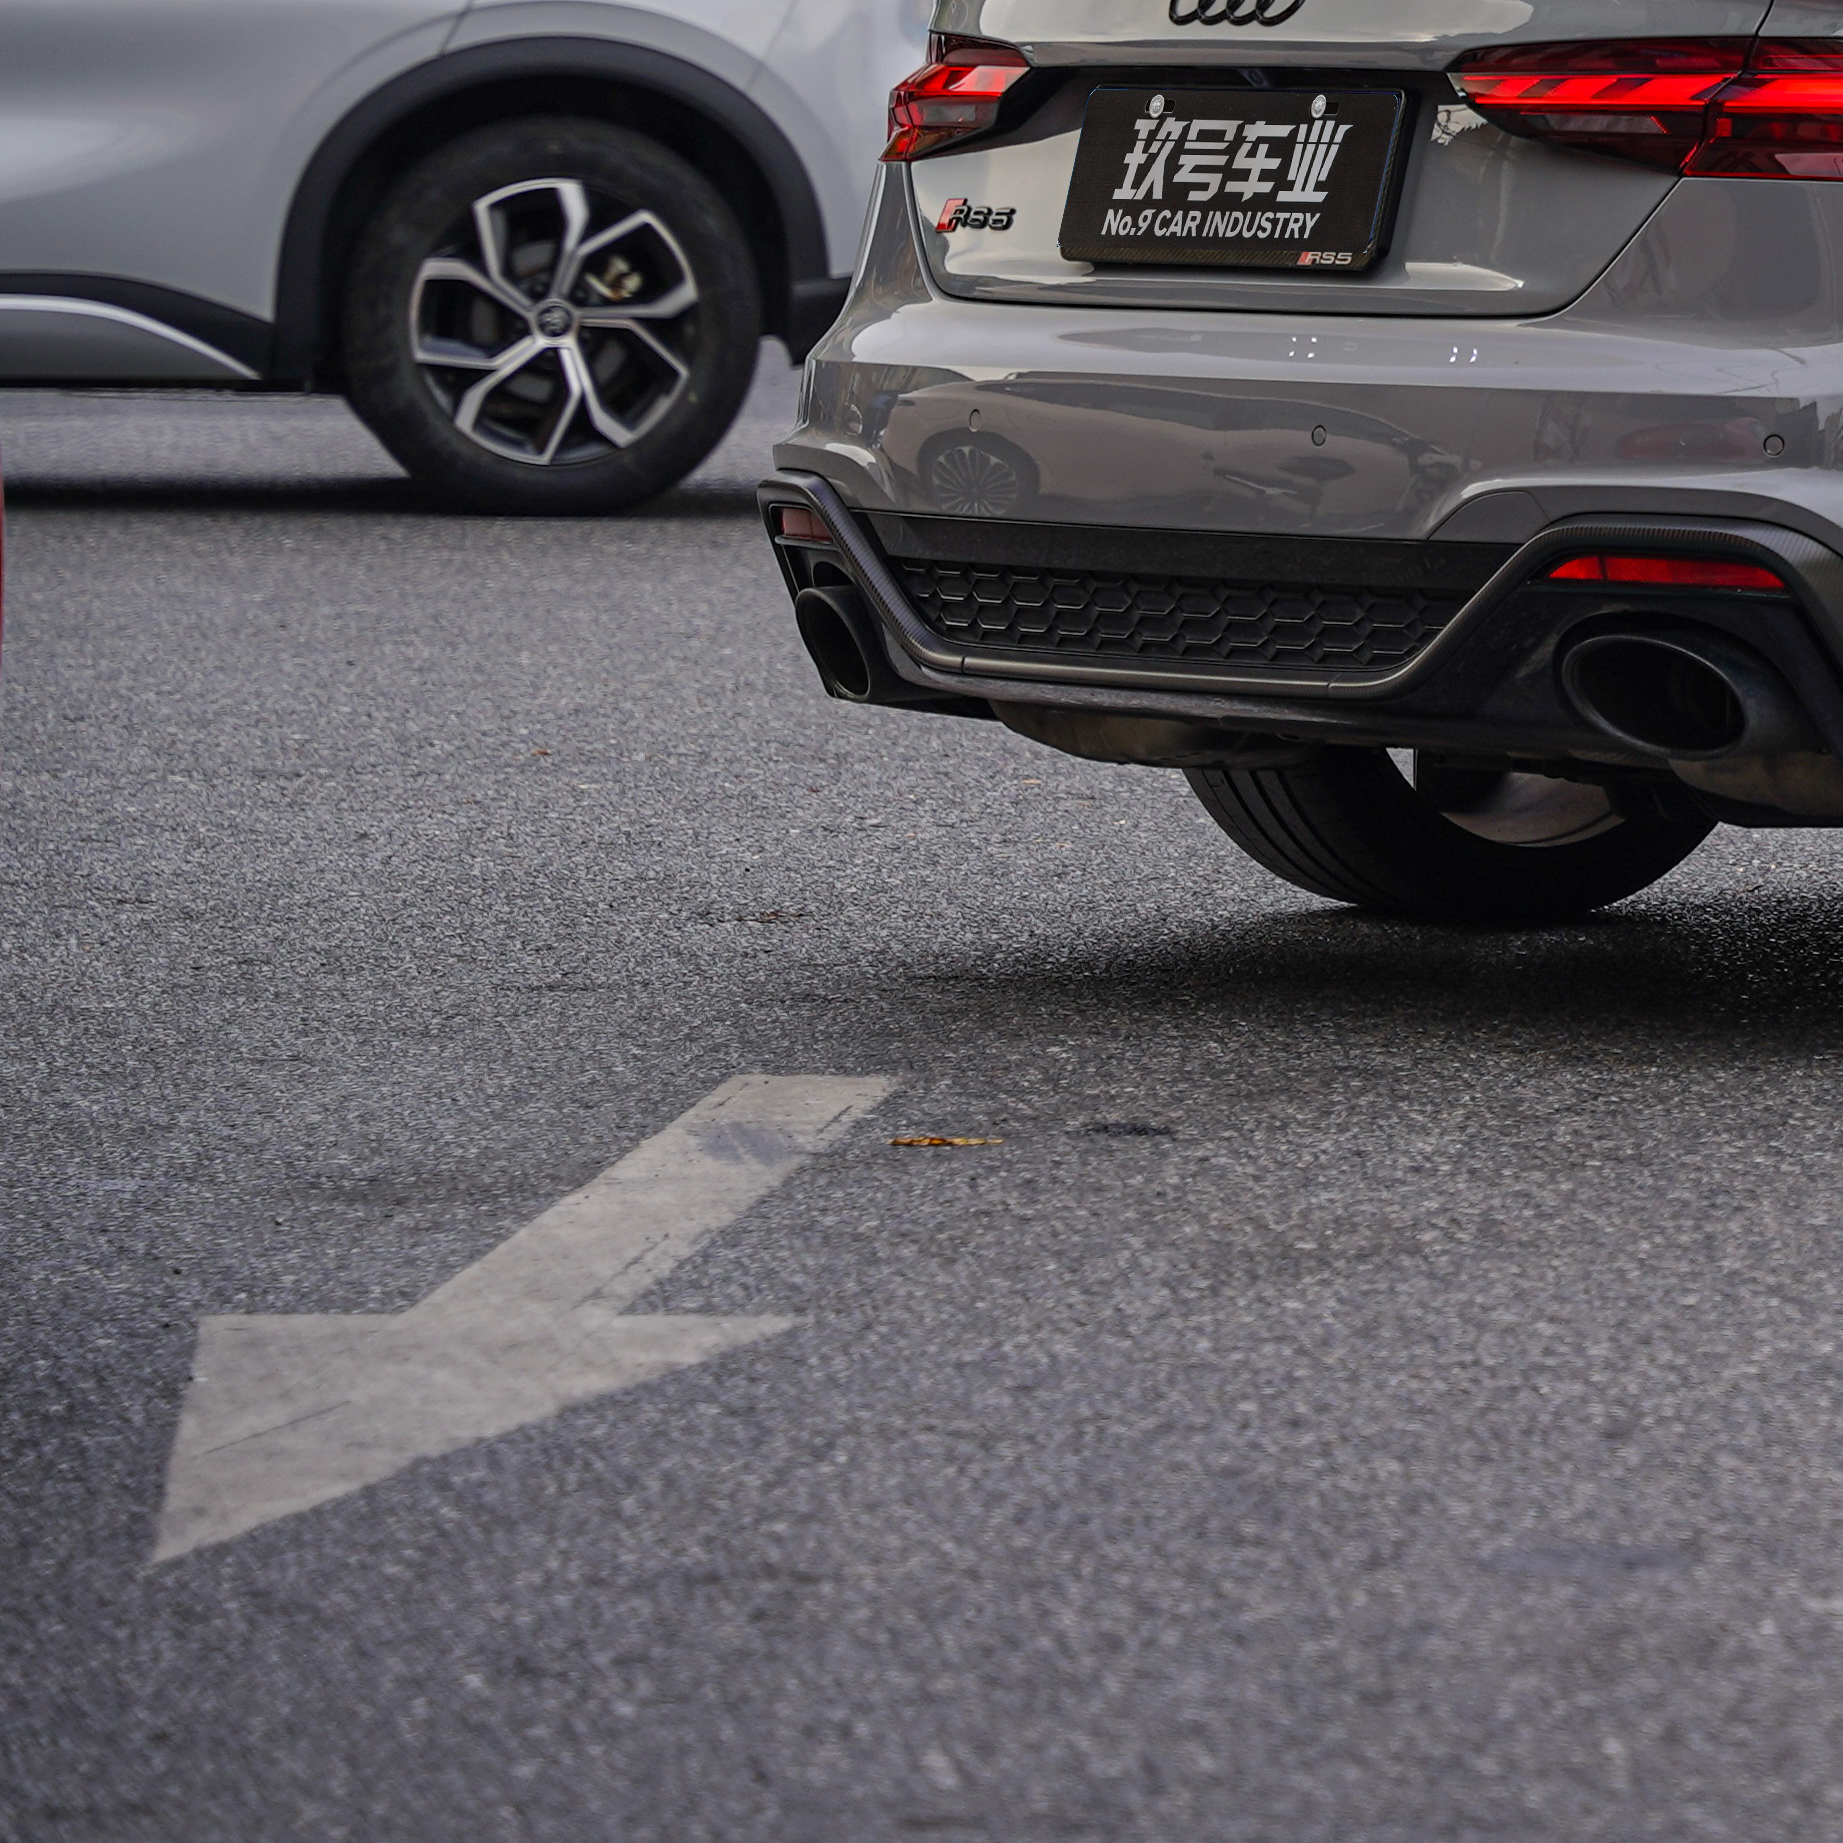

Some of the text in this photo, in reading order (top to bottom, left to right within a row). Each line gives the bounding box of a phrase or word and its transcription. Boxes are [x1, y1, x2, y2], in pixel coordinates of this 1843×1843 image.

[1112, 117, 1353, 202] 玖号车业
[935, 198, 1017, 233] RS5
[1101, 209, 1321, 239] No.9 CAR INDUSTRY
[1297, 251, 1352, 265] RS5
